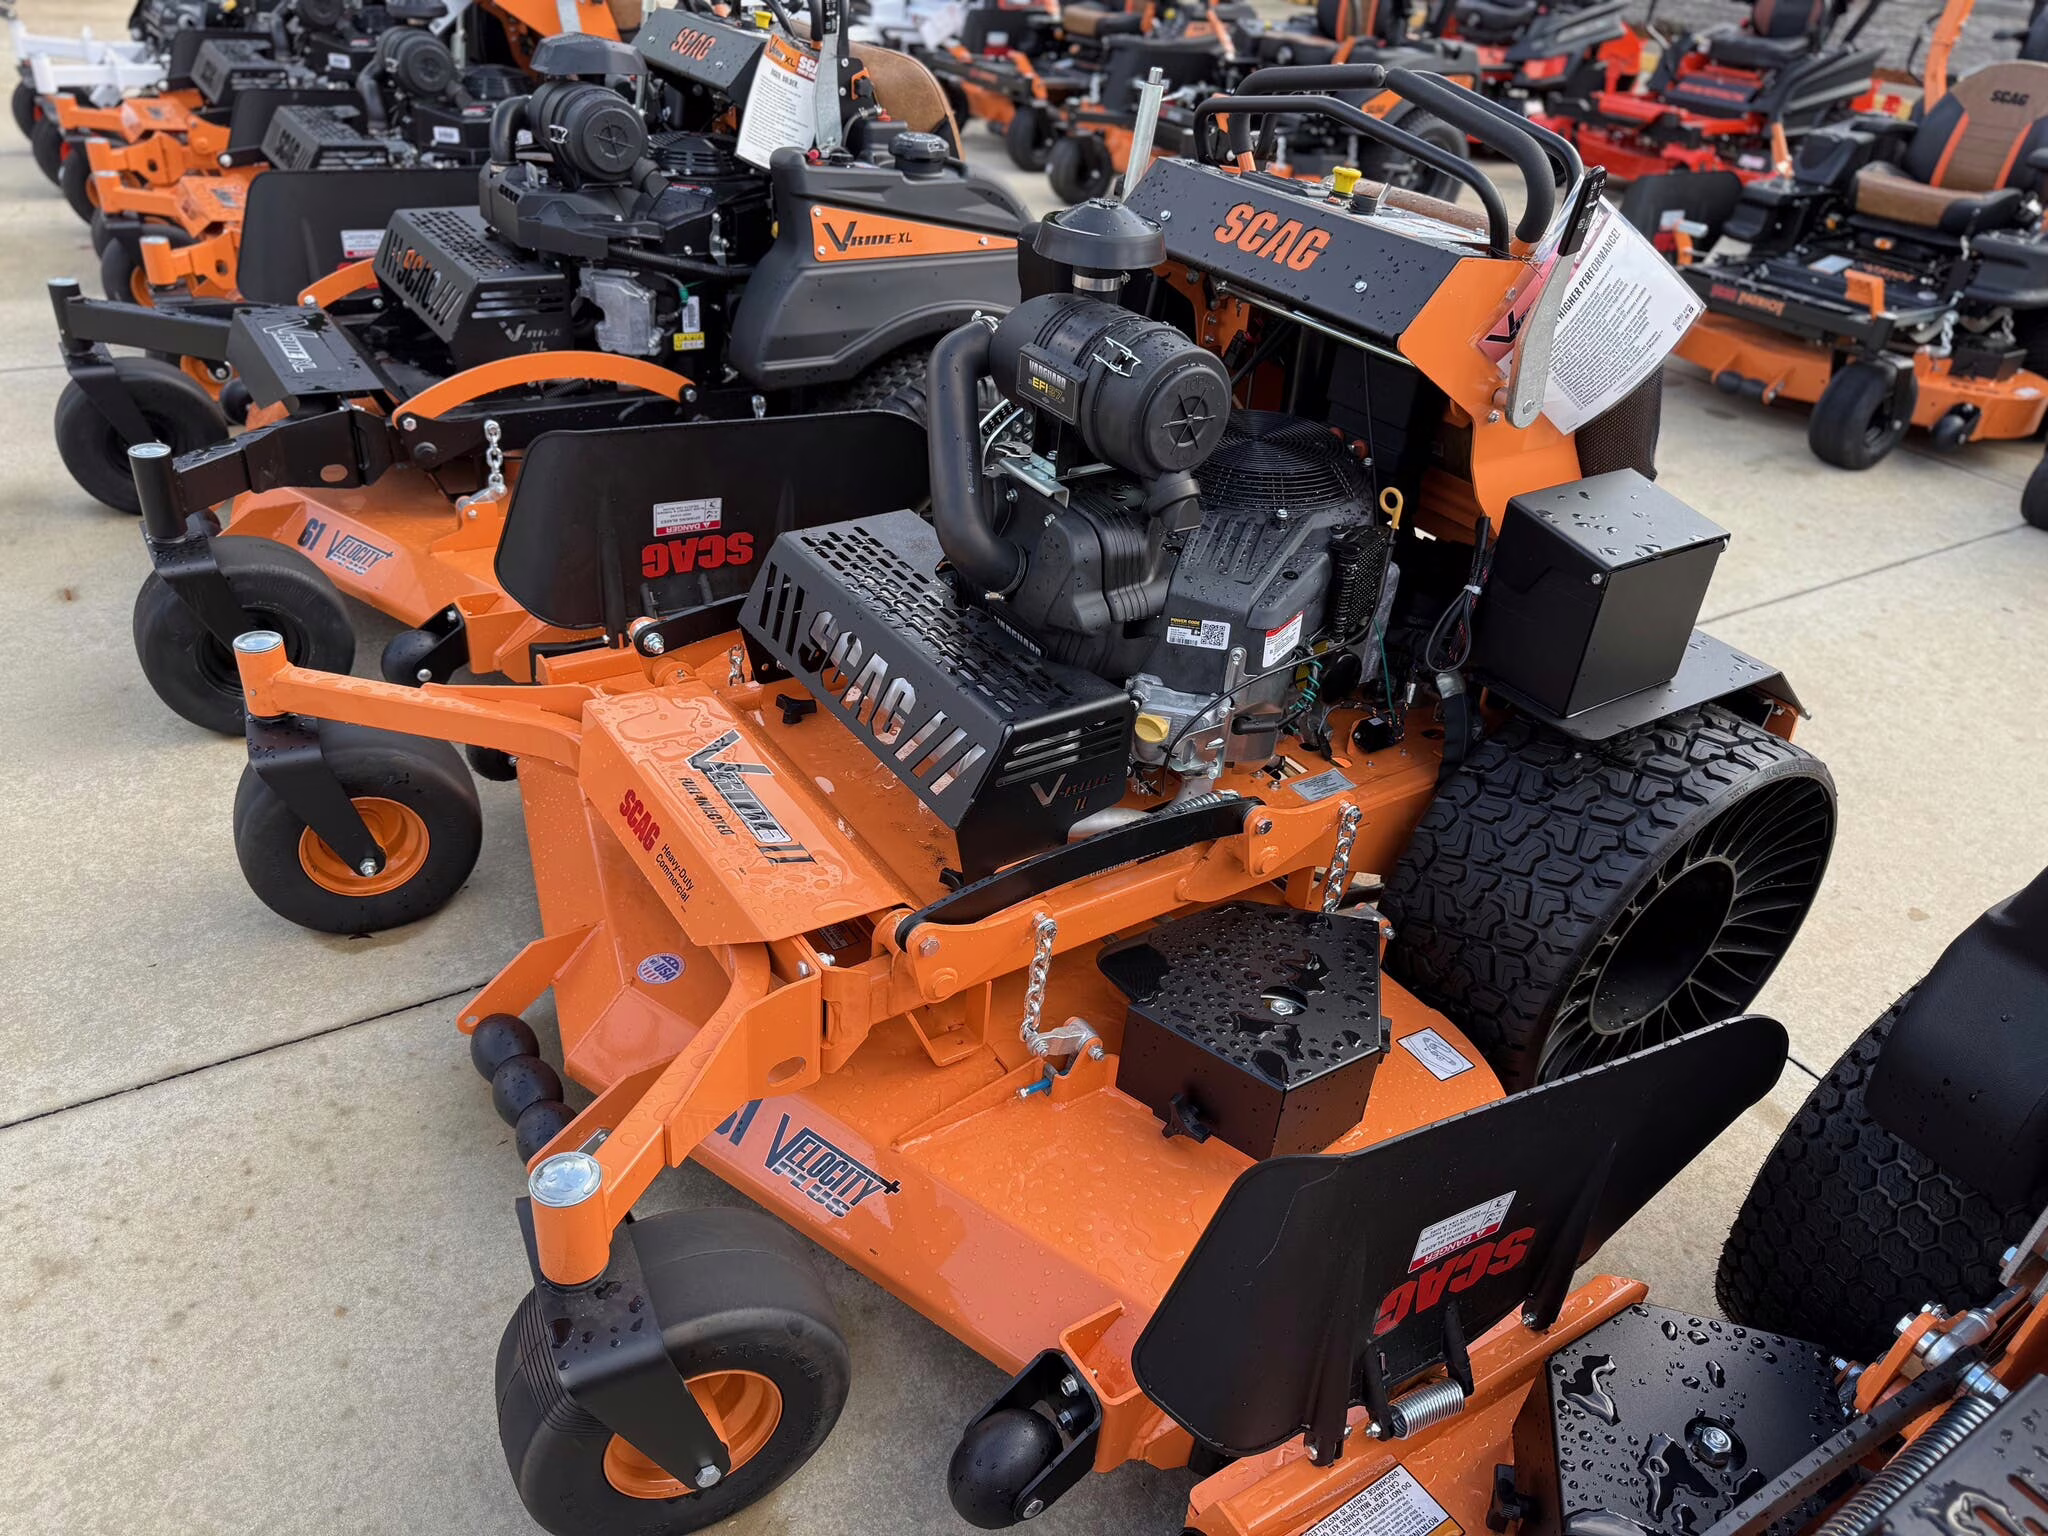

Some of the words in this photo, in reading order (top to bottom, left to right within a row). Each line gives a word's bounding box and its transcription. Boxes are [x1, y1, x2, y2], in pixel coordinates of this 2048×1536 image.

[671, 27, 717, 61] SCAG
[1990, 90, 2029, 107] SCAG
[898, 232, 913, 244] XL
[1213, 202, 1332, 272] SCAG
[1555, 285, 1583, 319] HIGHER
[1577, 227, 1621, 290] PERFORMANCE!
[1029, 359, 1067, 391] VANGUARD
[297, 517, 327, 551] 61
[666, 523, 700, 534] DANGER
[642, 532, 754, 579] SCAG
[799, 611, 917, 745] SCAG
[619, 789, 661, 851] SCAG
[655, 853, 690, 902] Commercial
[662, 843, 695, 891] Heavy-Duty
[653, 962, 677, 981] USA
[714, 1098, 764, 1147] 1
[772, 1160, 851, 1218] PLUS
[1445, 1224, 1476, 1242] SPINNING
[1452, 1224, 1465, 1233] KEEP
[1420, 1238, 1444, 1253] BLADES
[1424, 1236, 1473, 1262] DANGER
[1373, 1227, 1537, 1337] SCAG
[1365, 1469, 1400, 1497] DISCHARGE
[1368, 1479, 1400, 1504] CATCHER,
[1387, 1487, 1402, 1500] NOT
[1400, 1480, 1412, 1491] DO
[1338, 1507, 1347, 1516] IS
[1338, 1499, 1371, 1526] MULCHING
[1345, 1493, 1368, 1511] CHUTE
[1360, 1496, 1389, 1520] OPERATE
[1327, 1522, 1341, 1534] KIT
[1337, 1516, 1363, 1536] UNLESS
